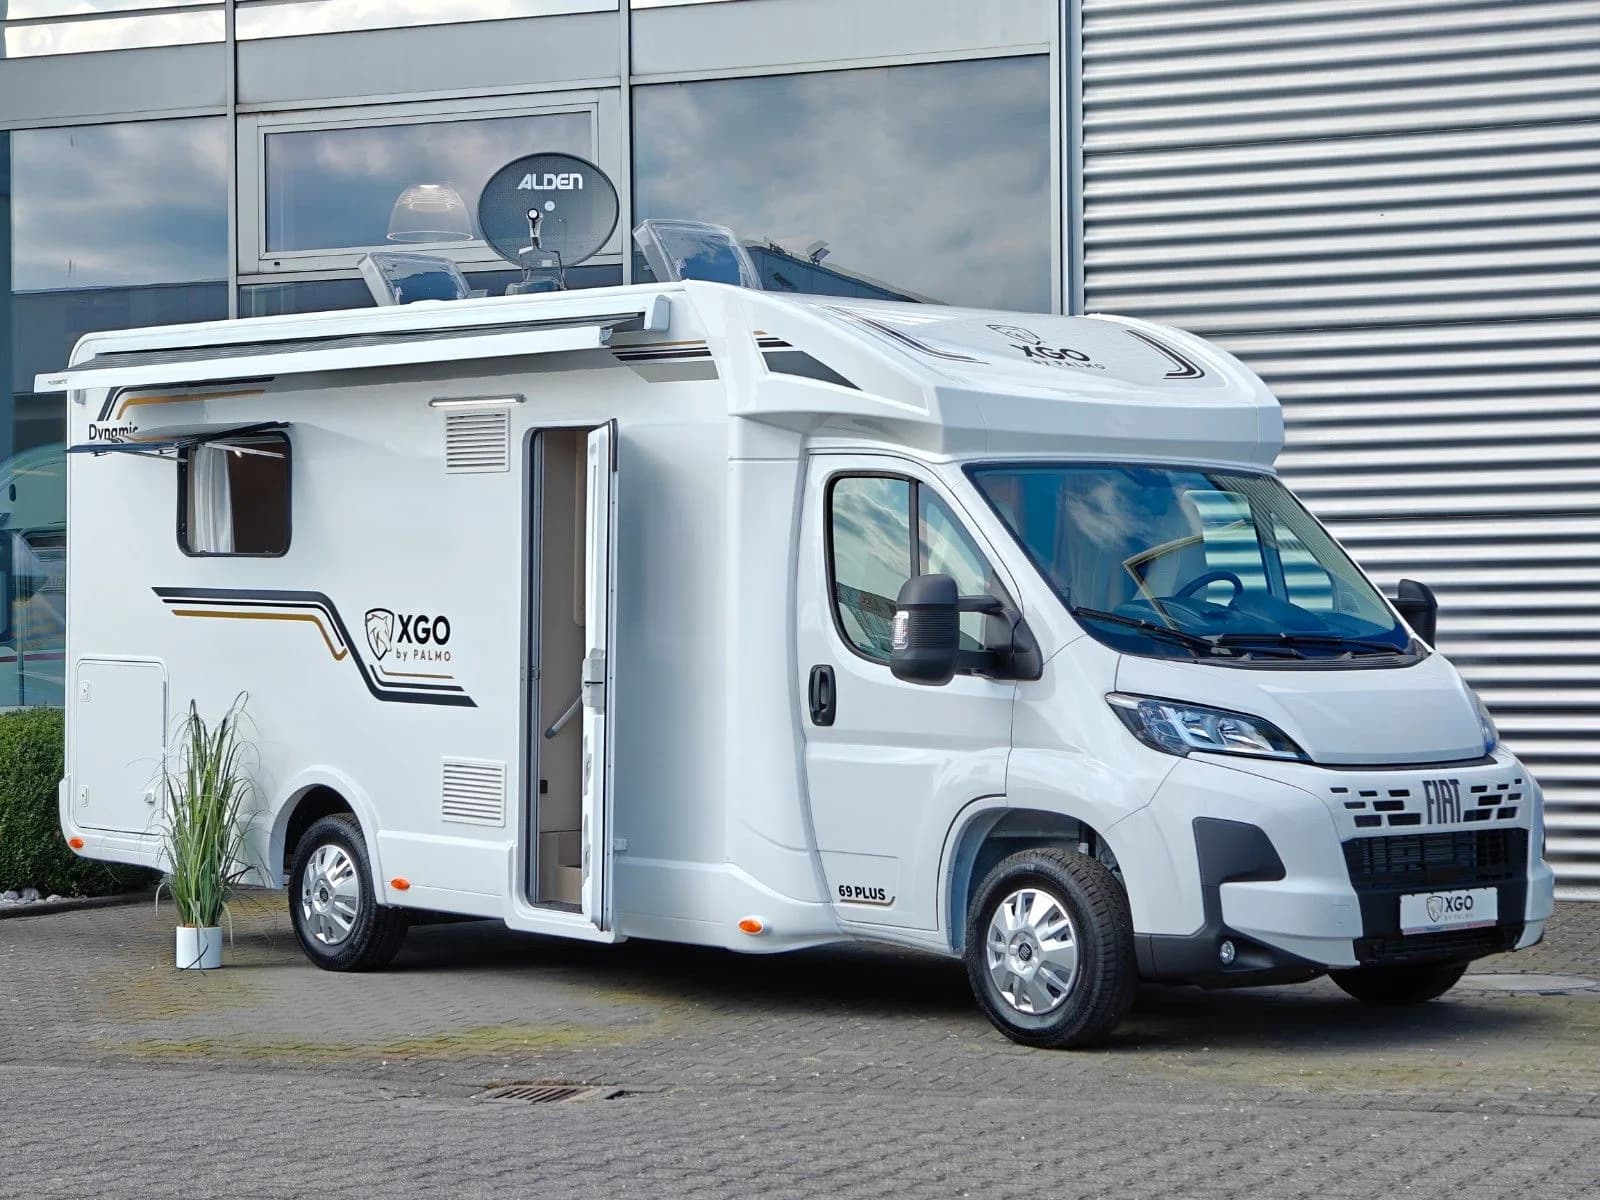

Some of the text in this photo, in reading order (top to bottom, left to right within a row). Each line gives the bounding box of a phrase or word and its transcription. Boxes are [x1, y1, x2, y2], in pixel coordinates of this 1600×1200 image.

[517, 173, 583, 190] ALDEN
[1008, 343, 1091, 362] XGO
[397, 614, 451, 645] XGO
[396, 648, 452, 662] by PALMO
[1422, 779, 1462, 825] FIAT
[838, 884, 886, 901] 69 PLUS
[1445, 895, 1474, 913] XGO
